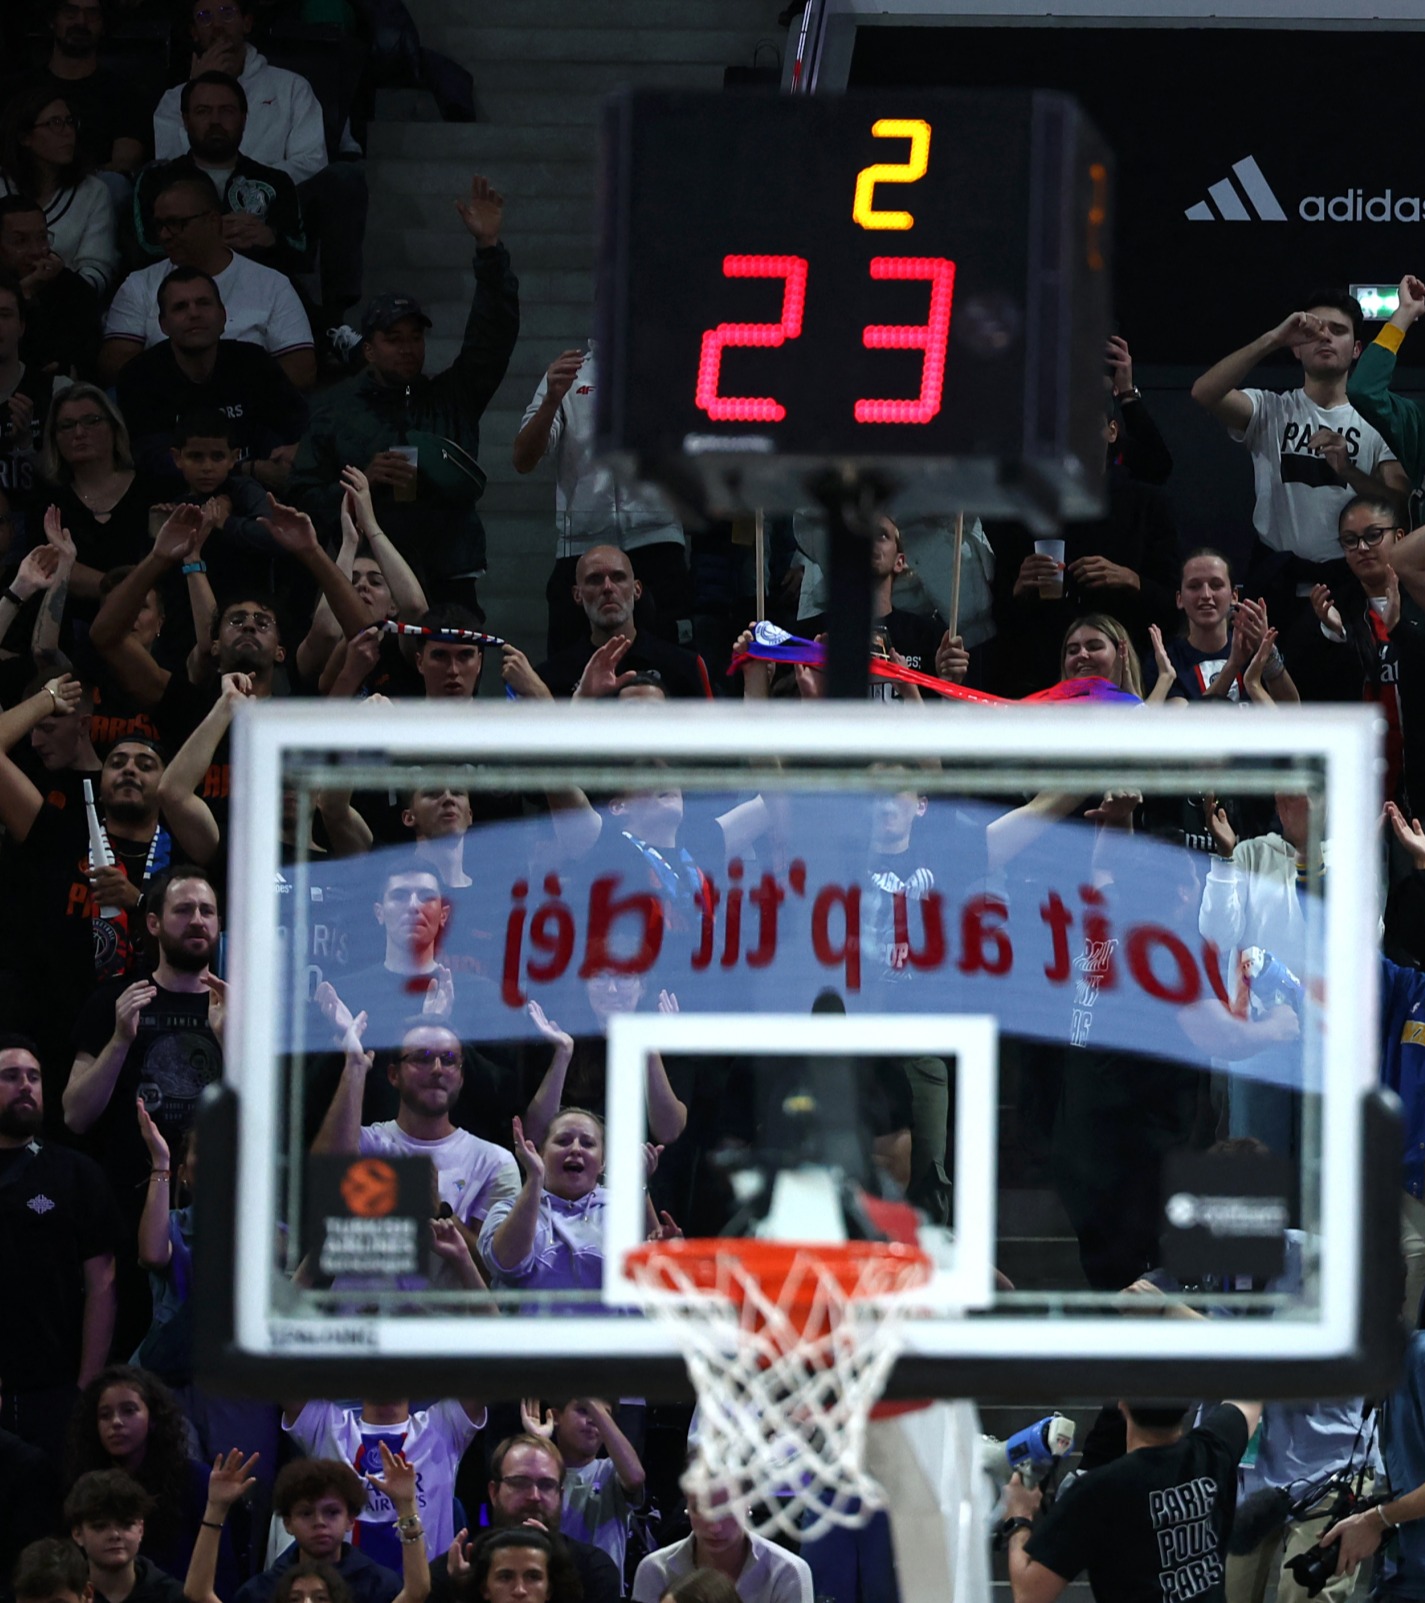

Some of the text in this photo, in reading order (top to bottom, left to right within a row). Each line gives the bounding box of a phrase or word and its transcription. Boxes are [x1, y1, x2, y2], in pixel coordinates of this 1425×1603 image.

[852, 118, 932, 231] 2
[695, 254, 957, 425] 23
[1280, 422, 1362, 459] PAS
[1149, 1476, 1218, 1529] PARIS
[1156, 1516, 1219, 1569] POUR
